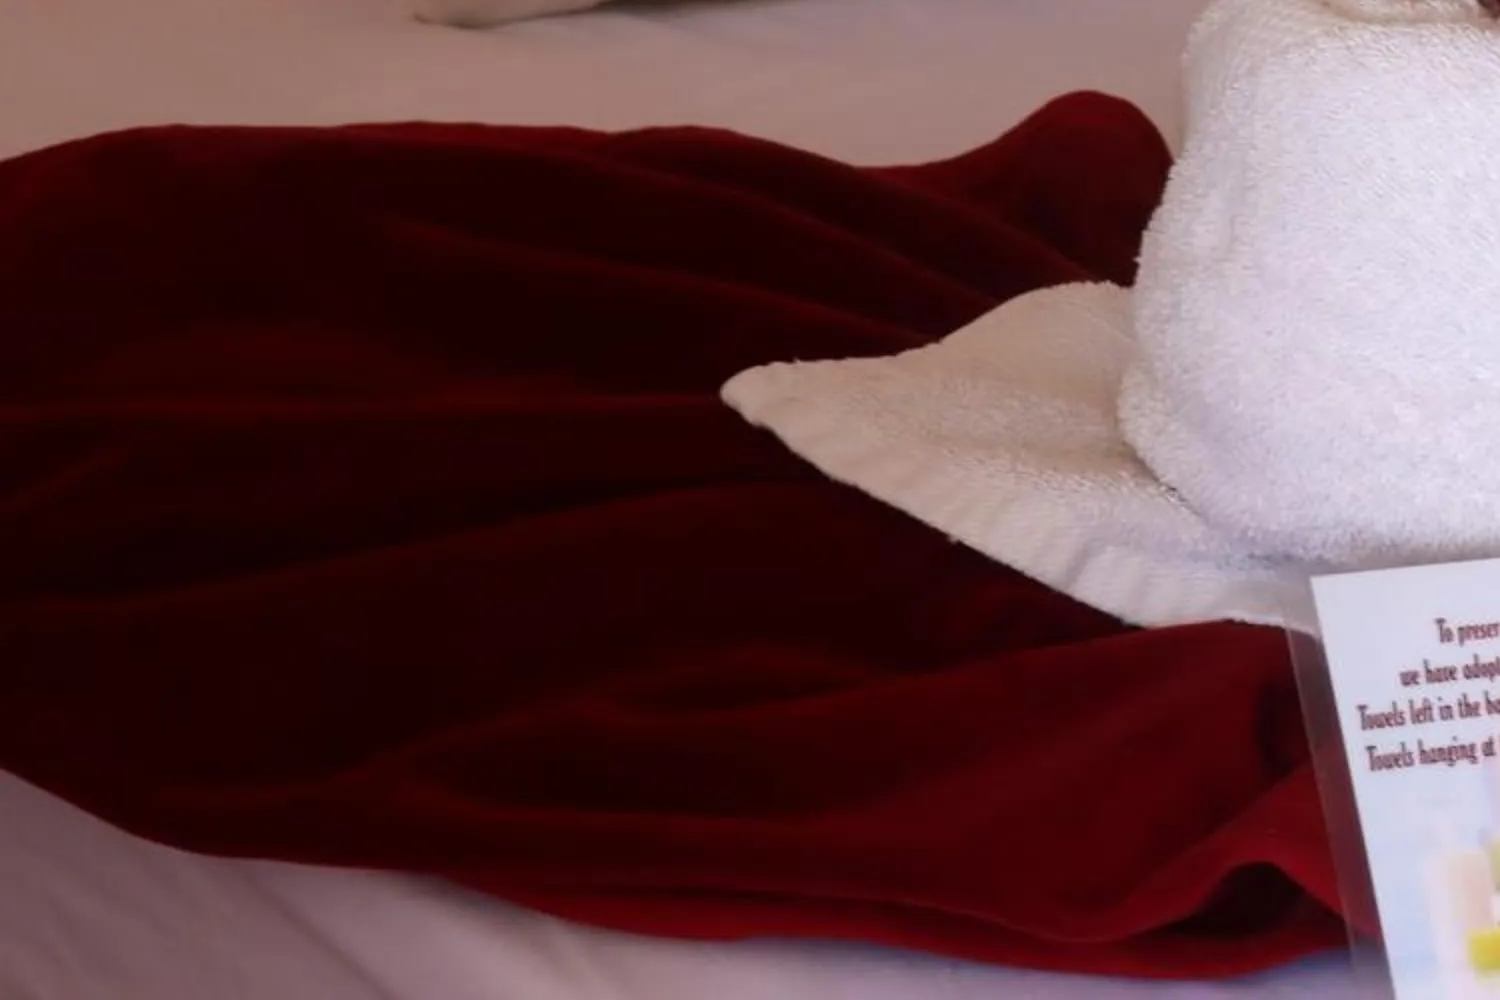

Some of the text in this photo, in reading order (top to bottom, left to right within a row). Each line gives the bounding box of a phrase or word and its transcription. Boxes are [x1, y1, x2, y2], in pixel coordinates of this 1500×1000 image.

[1435, 617, 1454, 643] To
[1400, 671, 1420, 686] we
[1423, 659, 1457, 683] have
[1357, 700, 1405, 730] Towels
[1408, 697, 1435, 724] left
[1438, 697, 1454, 721] in
[1458, 693, 1482, 718] the
[1366, 741, 1414, 771] Towels
[1417, 736, 1478, 766] hanging
[1482, 736, 1496, 757] at
